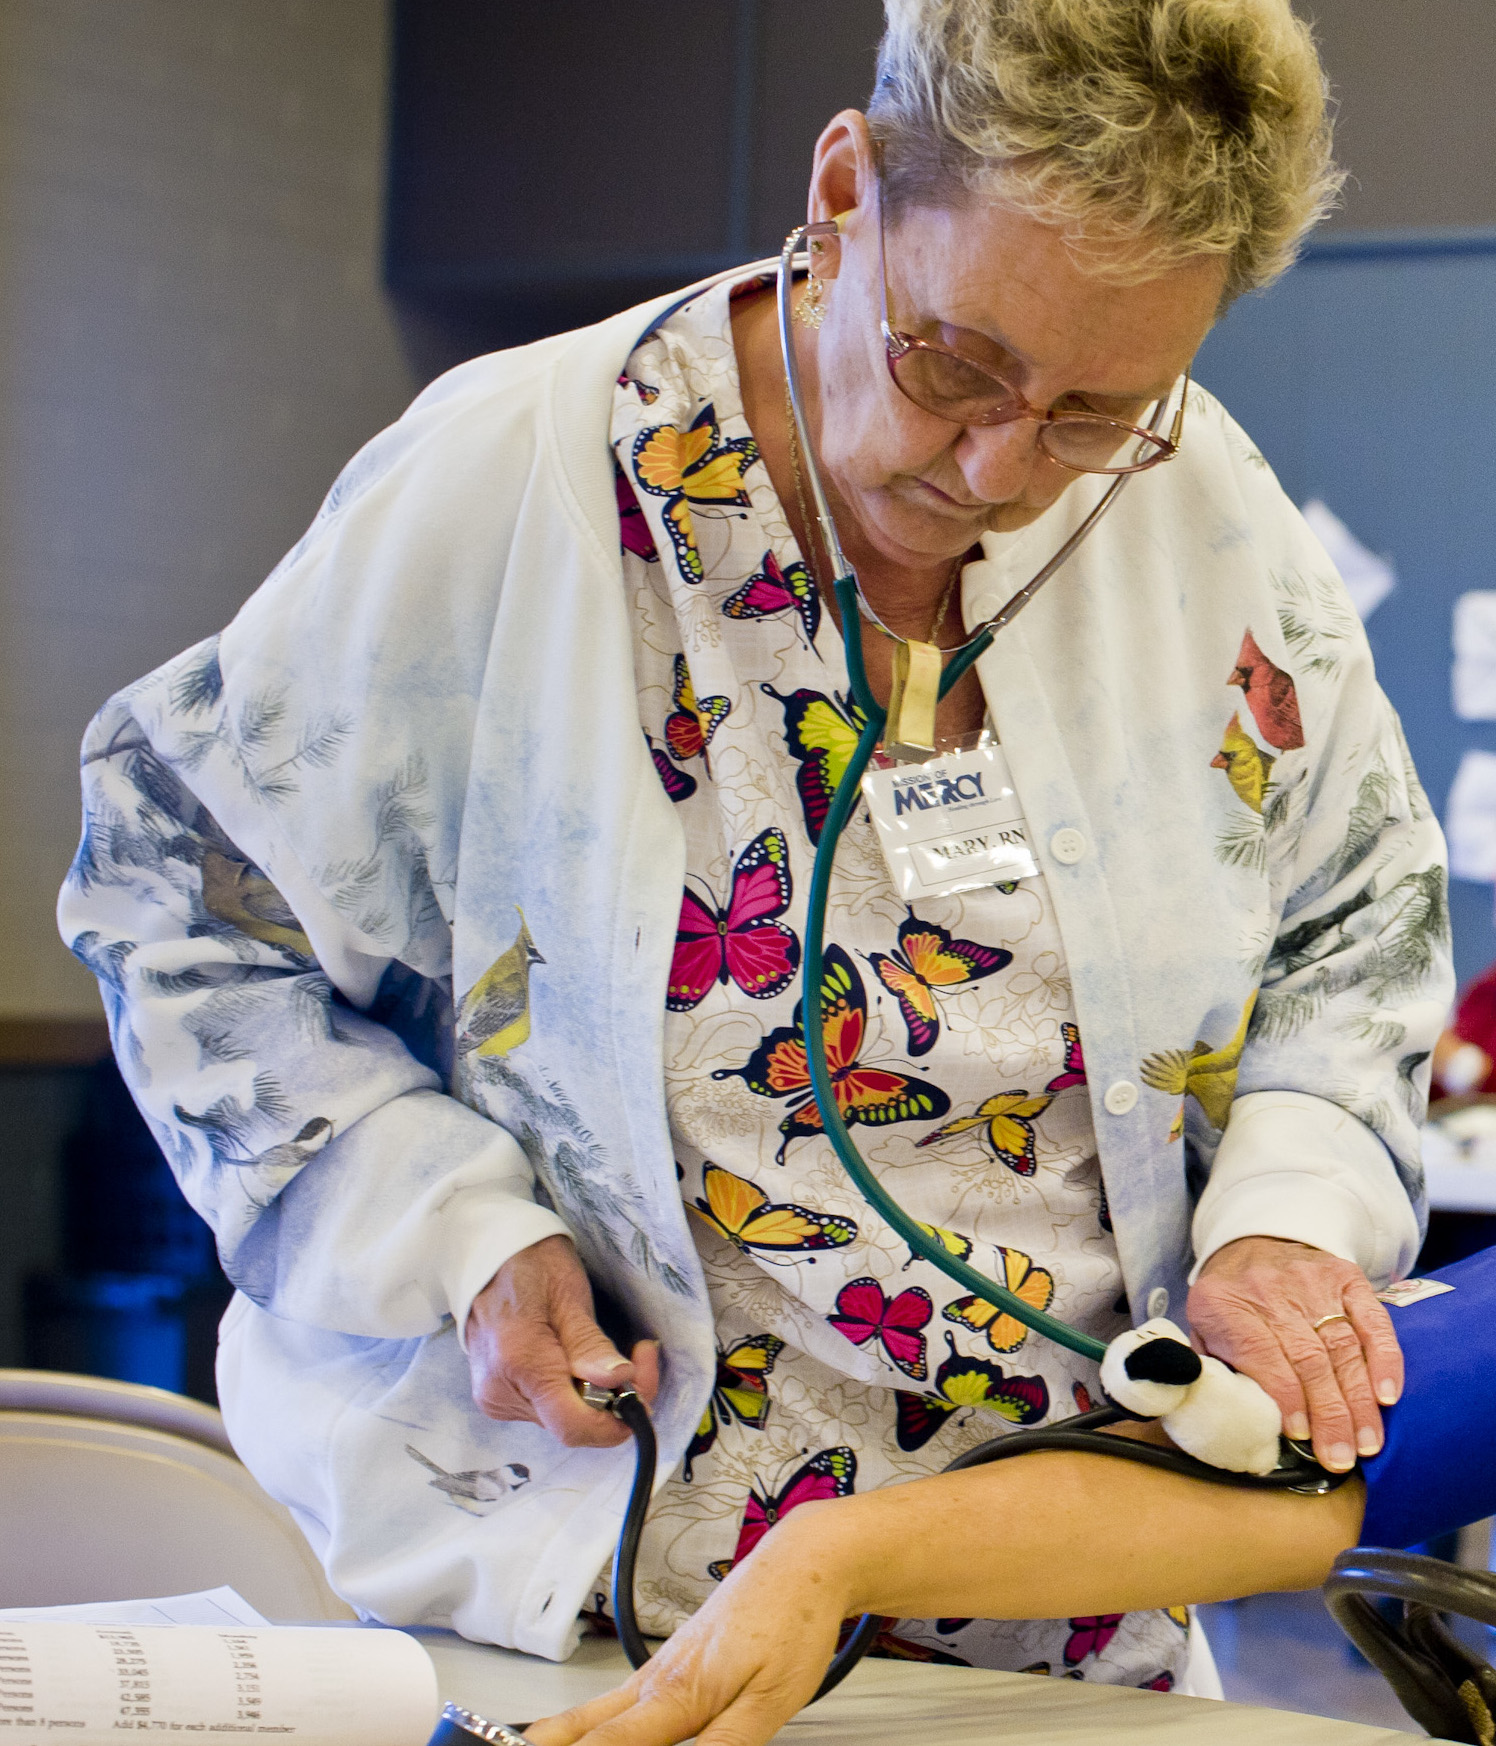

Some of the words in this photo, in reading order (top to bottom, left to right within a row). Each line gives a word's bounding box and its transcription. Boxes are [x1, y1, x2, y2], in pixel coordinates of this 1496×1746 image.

[934, 769, 947, 779] OF
[893, 771, 985, 816] MERCY
[997, 827, 1027, 846] RN
[15, 1716, 37, 1727] than
[48, 1719, 86, 1731] persons
[112, 1719, 134, 1729] Add
[185, 1721, 206, 1731] each
[208, 1722, 256, 1733] additional
[257, 1723, 297, 1734] member
